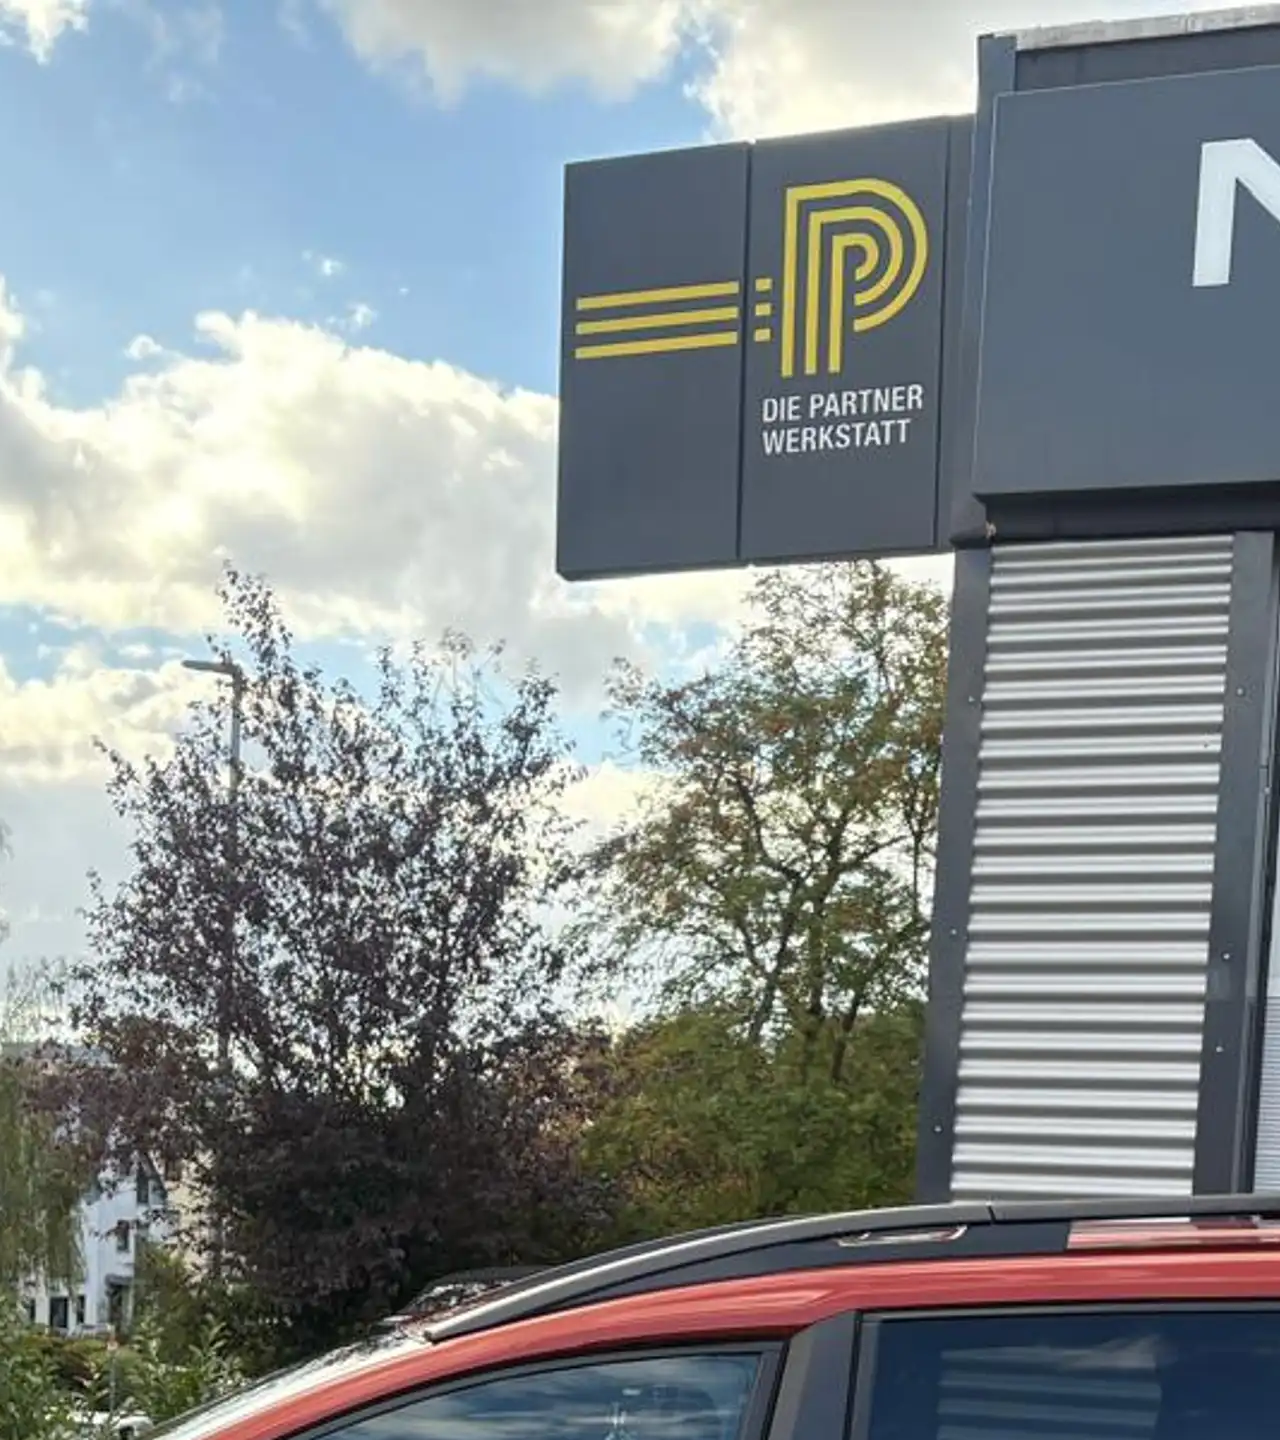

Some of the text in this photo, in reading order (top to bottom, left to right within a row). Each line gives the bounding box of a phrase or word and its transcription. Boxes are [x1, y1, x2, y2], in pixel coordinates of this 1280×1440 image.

[762, 383, 924, 423] DIE PARTNER
[762, 418, 912, 456] WERKSTATT
